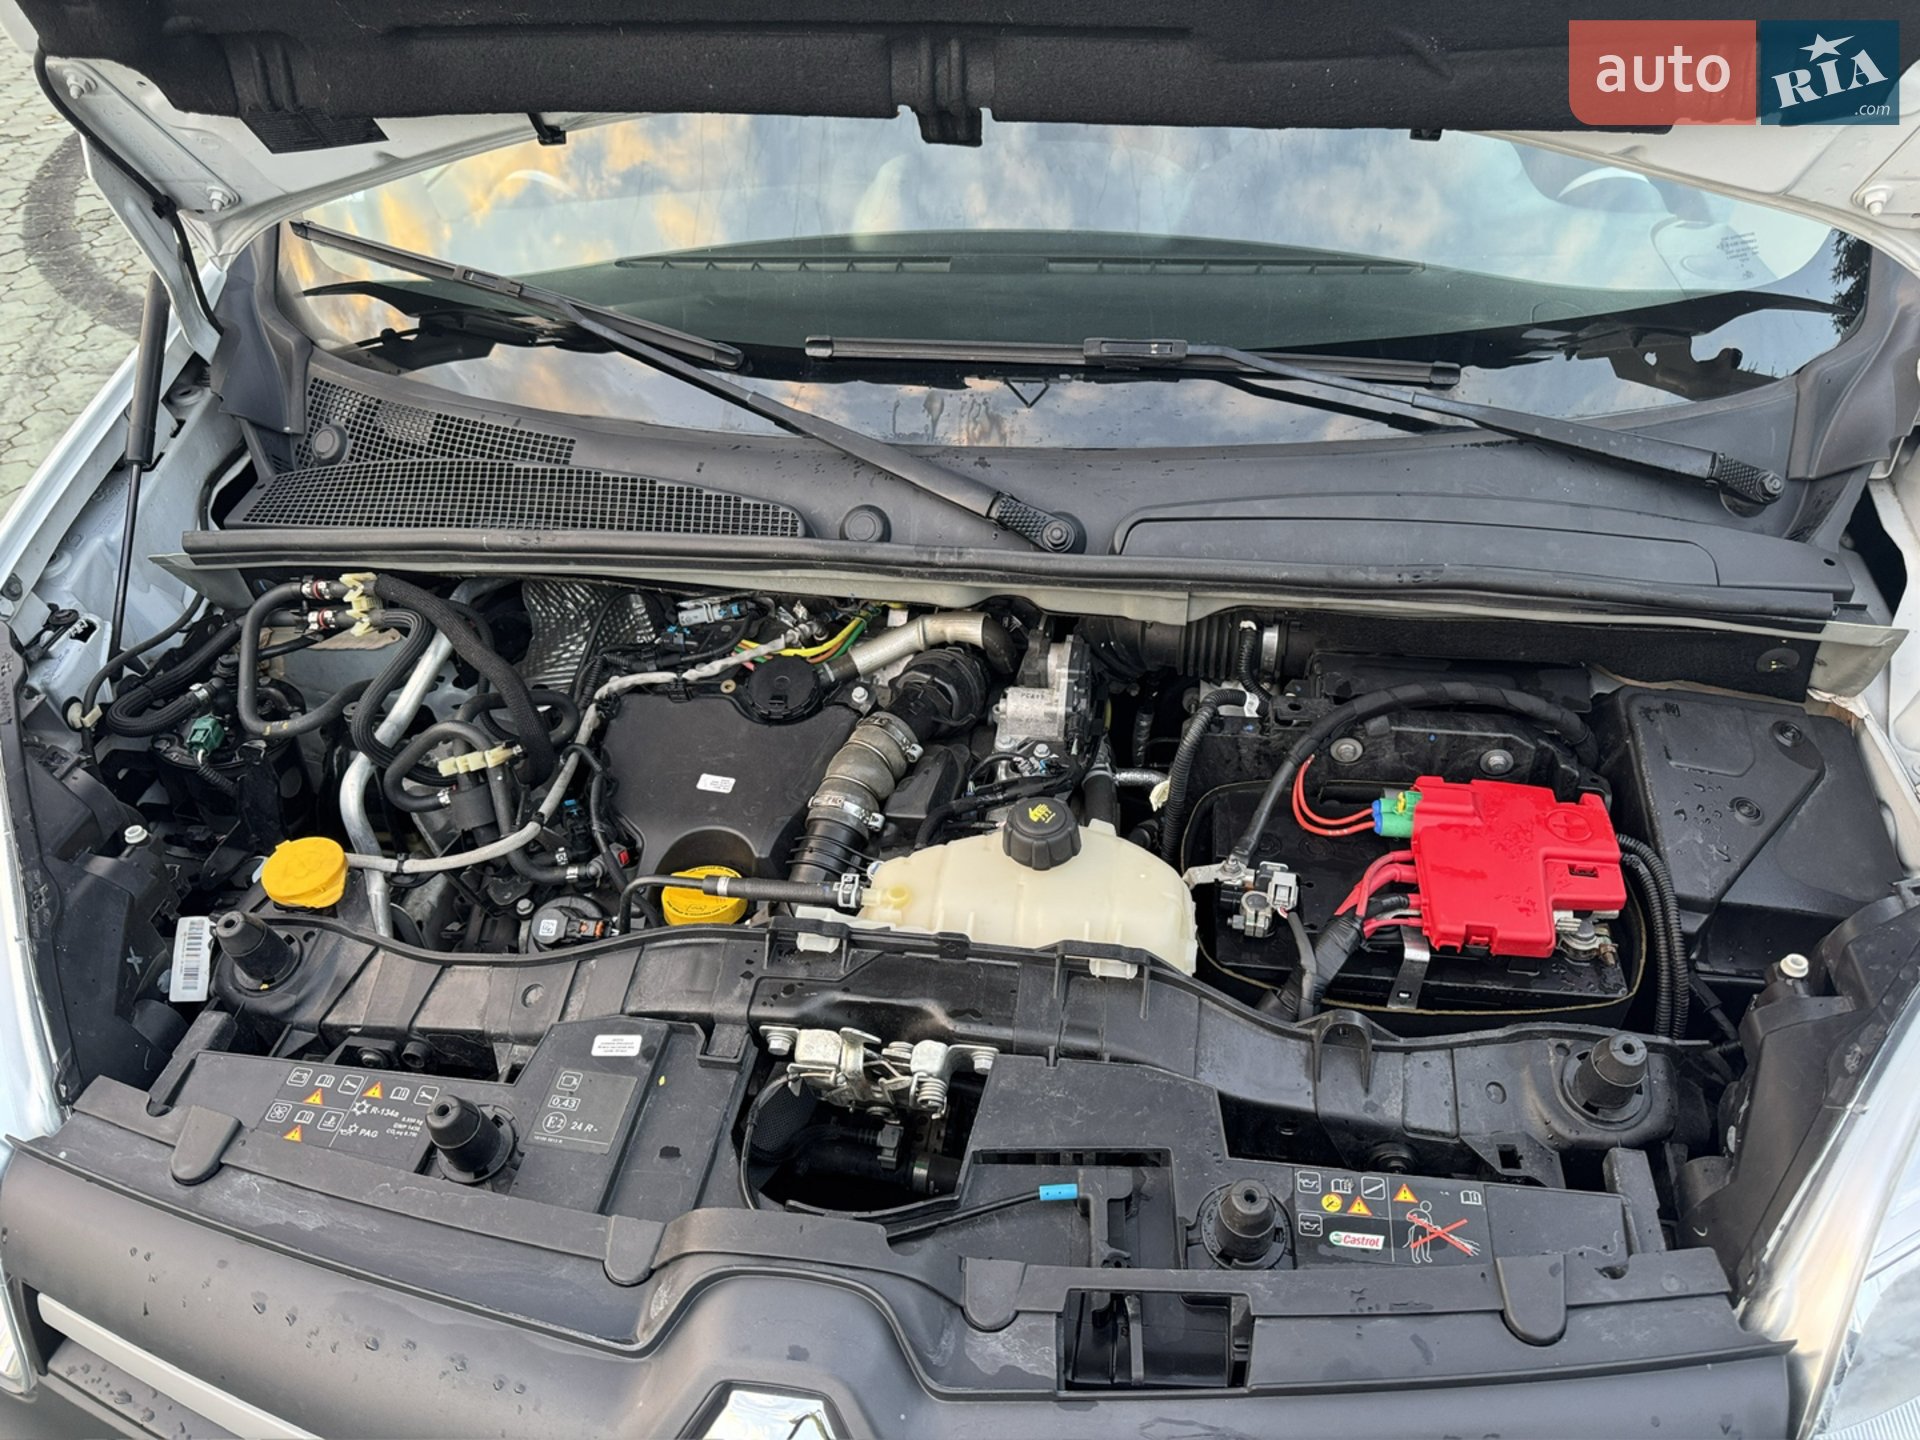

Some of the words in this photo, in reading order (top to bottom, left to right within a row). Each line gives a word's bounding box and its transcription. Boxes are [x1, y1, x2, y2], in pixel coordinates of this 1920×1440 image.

[552, 1097, 577, 1109] 0,43
[370, 1107, 399, 1118] R-134a
[546, 1115, 564, 1128] E2
[570, 1121, 583, 1131] 24
[359, 1128, 378, 1138] PAG
[1343, 1234, 1380, 1247] Castrol
